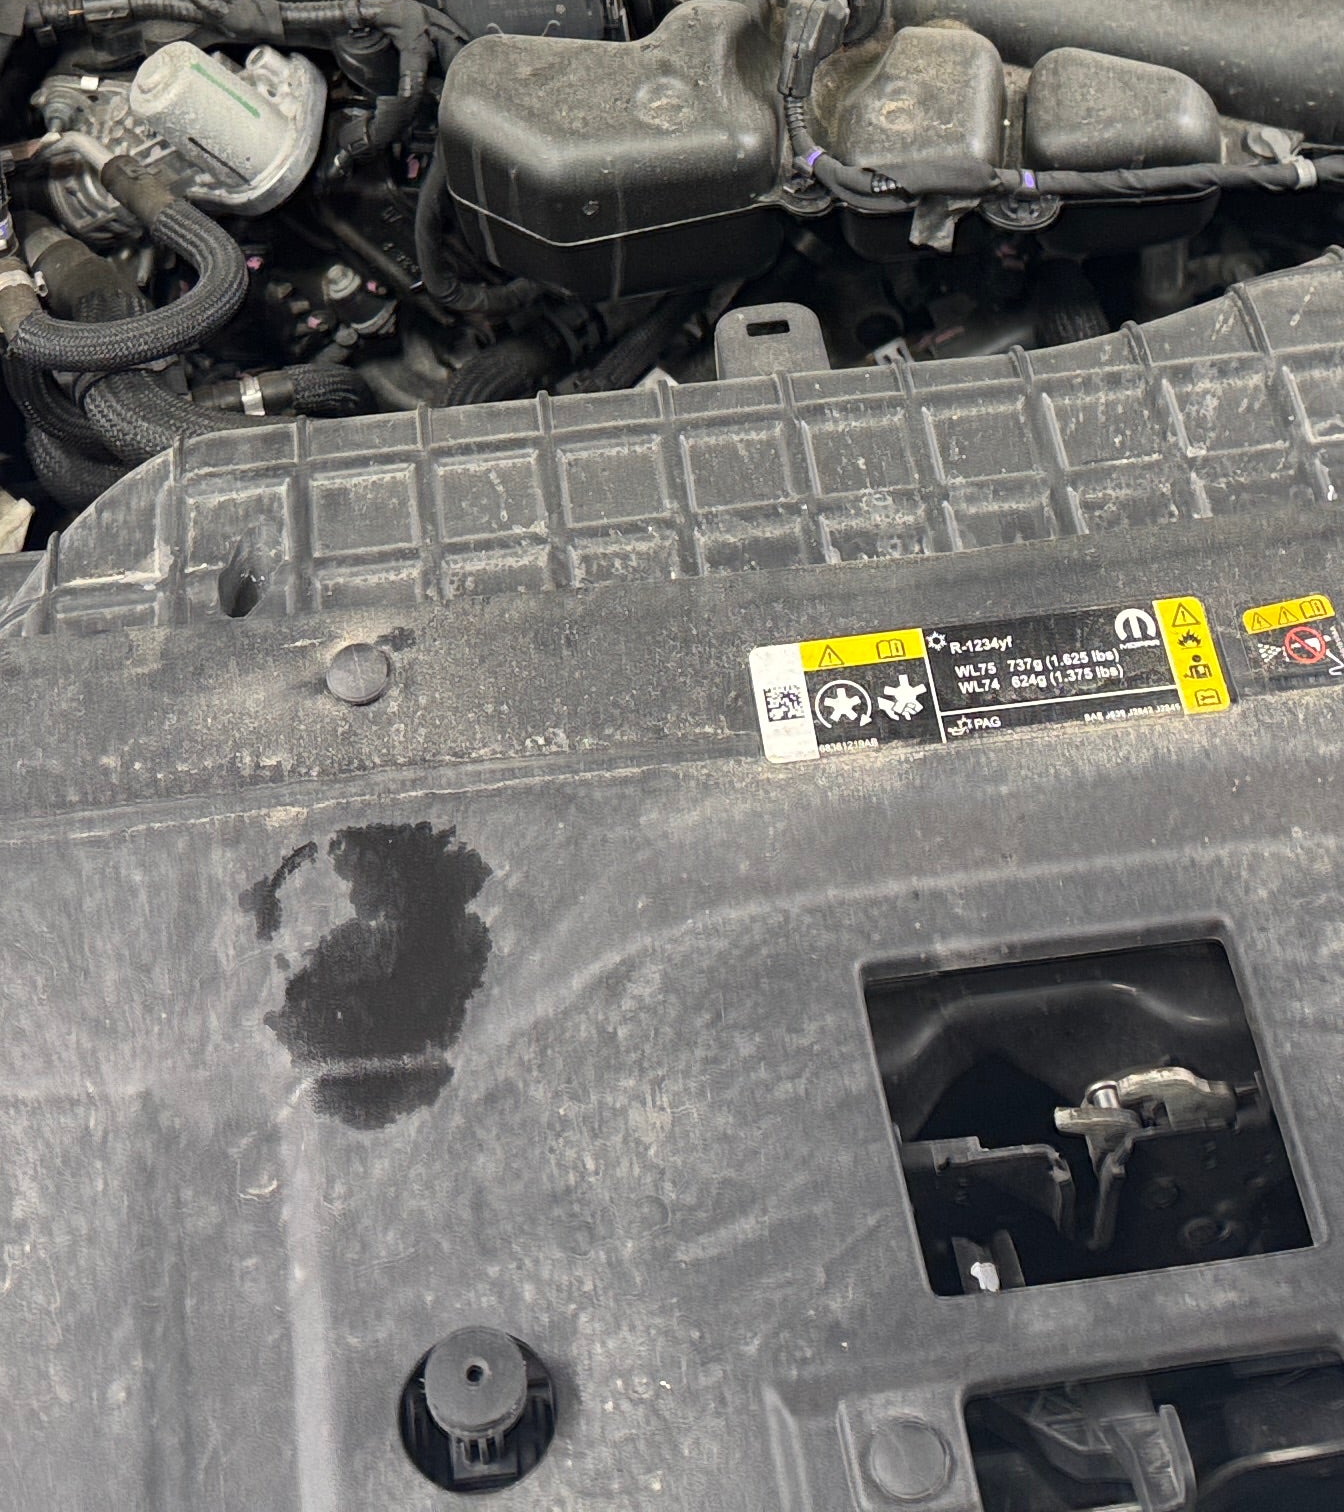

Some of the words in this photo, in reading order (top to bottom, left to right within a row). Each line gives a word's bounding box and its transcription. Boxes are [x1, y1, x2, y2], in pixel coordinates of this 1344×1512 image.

[950, 636, 1013, 654] R-1234yf
[955, 662, 996, 678] WL75
[1007, 659, 1043, 674] 737g
[1046, 650, 1088, 669] (1.625
[1092, 648, 1120, 663] lbs)
[958, 678, 1000, 694] WL74
[1012, 673, 1048, 690] 624g
[1050, 666, 1093, 686] (1.375
[1096, 663, 1123, 678] lbs)
[974, 716, 1001, 730] PAG
